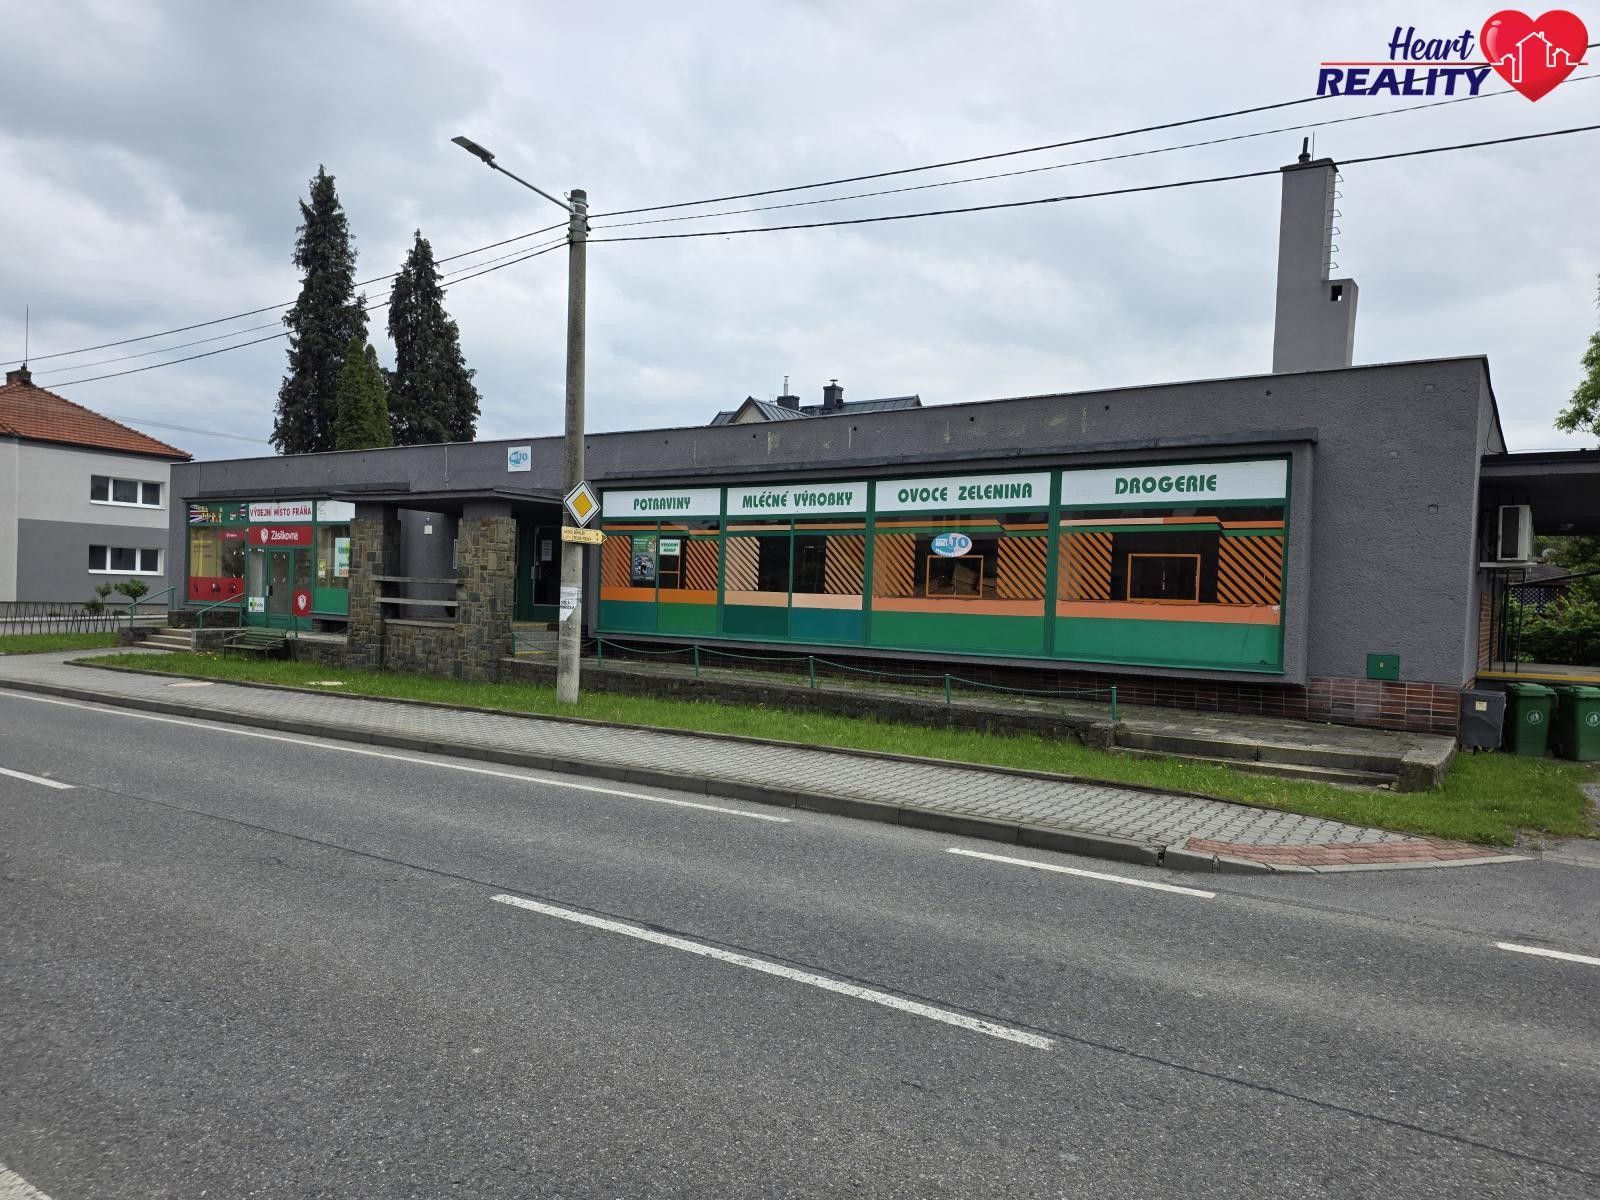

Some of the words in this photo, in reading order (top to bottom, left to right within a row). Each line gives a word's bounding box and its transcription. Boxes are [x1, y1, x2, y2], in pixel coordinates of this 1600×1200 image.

[1115, 474, 1217, 495] DROGERIE
[742, 490, 788, 508] MLÉČNÉ
[793, 490, 853, 507] VÝROBKY
[897, 486, 948, 503] OVOCE
[958, 483, 1033, 501] ZELENINA
[633, 497, 691, 510] POTRAVINY
[250, 507, 272, 517] VÝDEJNÍ
[274, 506, 290, 516] MÍSTO
[271, 530, 299, 540] Zásilkovna
